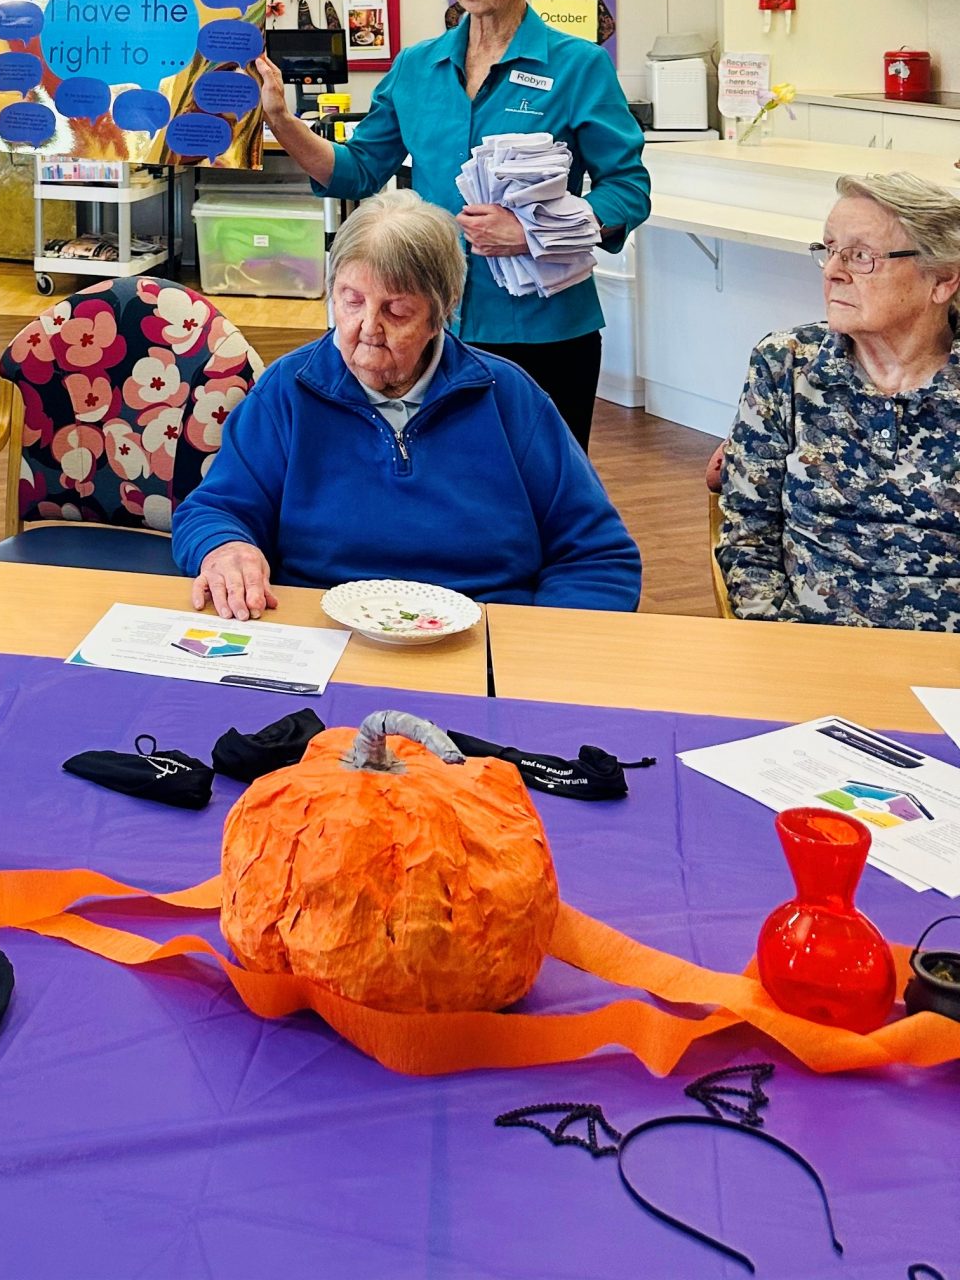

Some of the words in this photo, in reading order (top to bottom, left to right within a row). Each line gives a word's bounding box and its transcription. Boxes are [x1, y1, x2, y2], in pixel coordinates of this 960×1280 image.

[540, 12, 588, 24] October
[49, 35, 112, 73] right
[120, 41, 149, 65] to
[726, 59, 762, 69] Recycling
[739, 68, 760, 76] Cash
[516, 72, 547, 87] Robyn
[520, 759, 537, 768] you
[561, 777, 589, 785] RURAL
